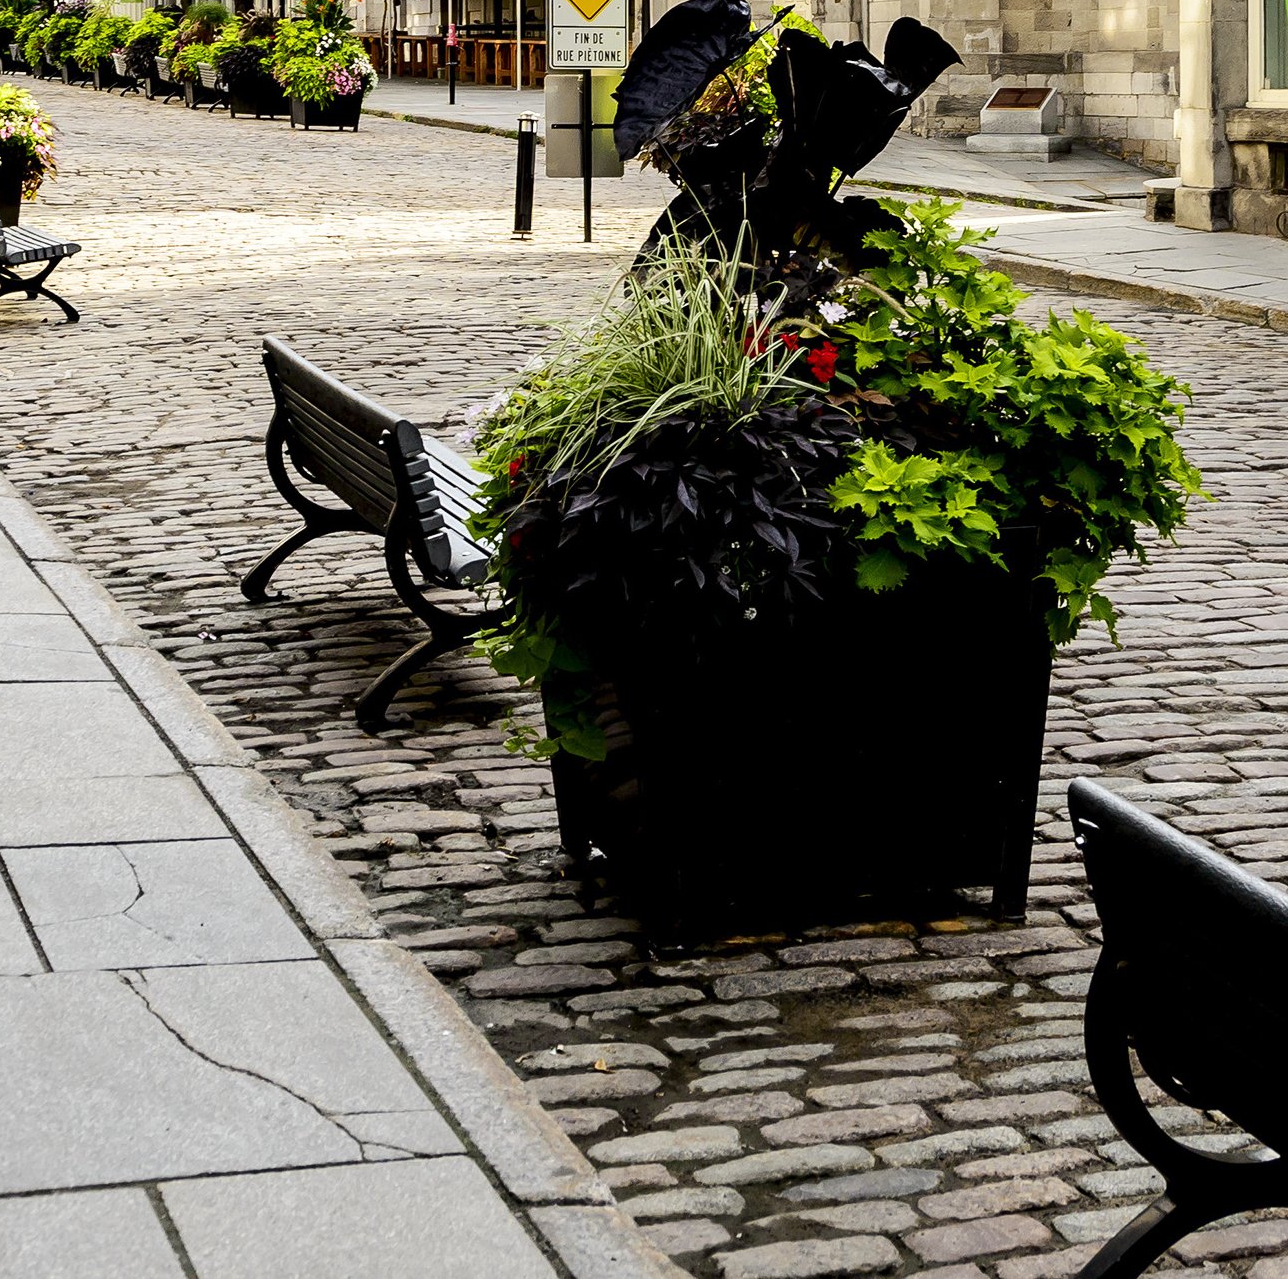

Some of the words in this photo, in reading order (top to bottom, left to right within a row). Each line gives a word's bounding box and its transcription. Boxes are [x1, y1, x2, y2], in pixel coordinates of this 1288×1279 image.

[574, 32, 589, 44] FIN
[593, 32, 604, 44] DE
[557, 50, 574, 62] RUE
